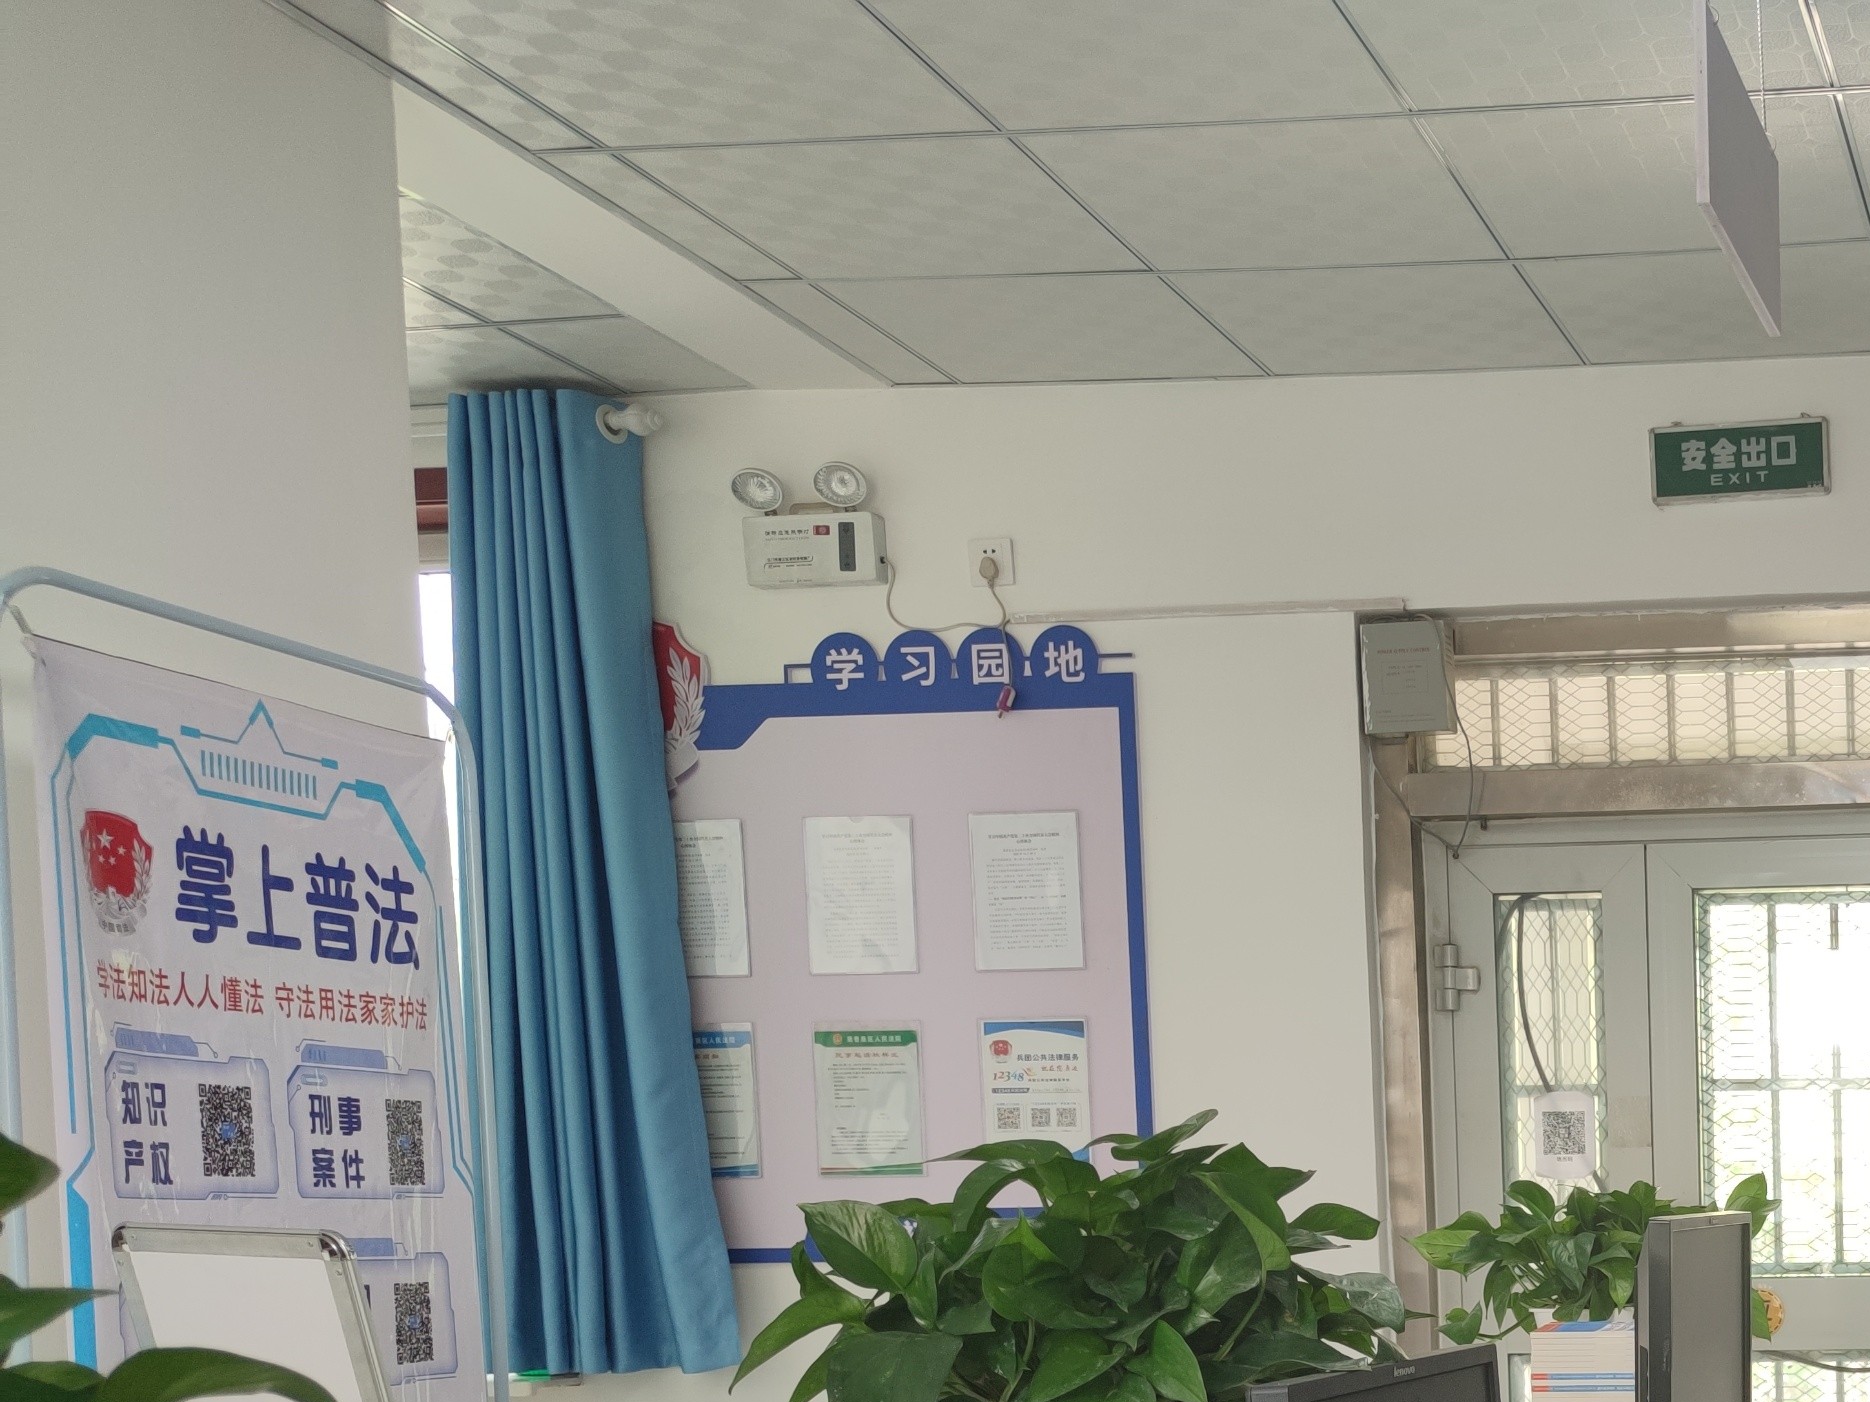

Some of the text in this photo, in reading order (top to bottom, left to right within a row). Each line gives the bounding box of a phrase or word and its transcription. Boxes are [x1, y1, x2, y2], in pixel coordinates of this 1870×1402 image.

[1681, 435, 1797, 472] 安全出口
[1710, 471, 1769, 486] EXIT
[825, 640, 1086, 691] 学习园地
[175, 825, 420, 970] 掌上普法
[96, 958, 428, 1031] 学法知法人人懂法 守法用法家家护法
[993, 1070, 1025, 1082] 12348
[121, 1080, 168, 1127] 知识
[308, 1094, 362, 1136] 刑事
[123, 1139, 174, 1186] 产权
[311, 1147, 366, 1189] 案件
